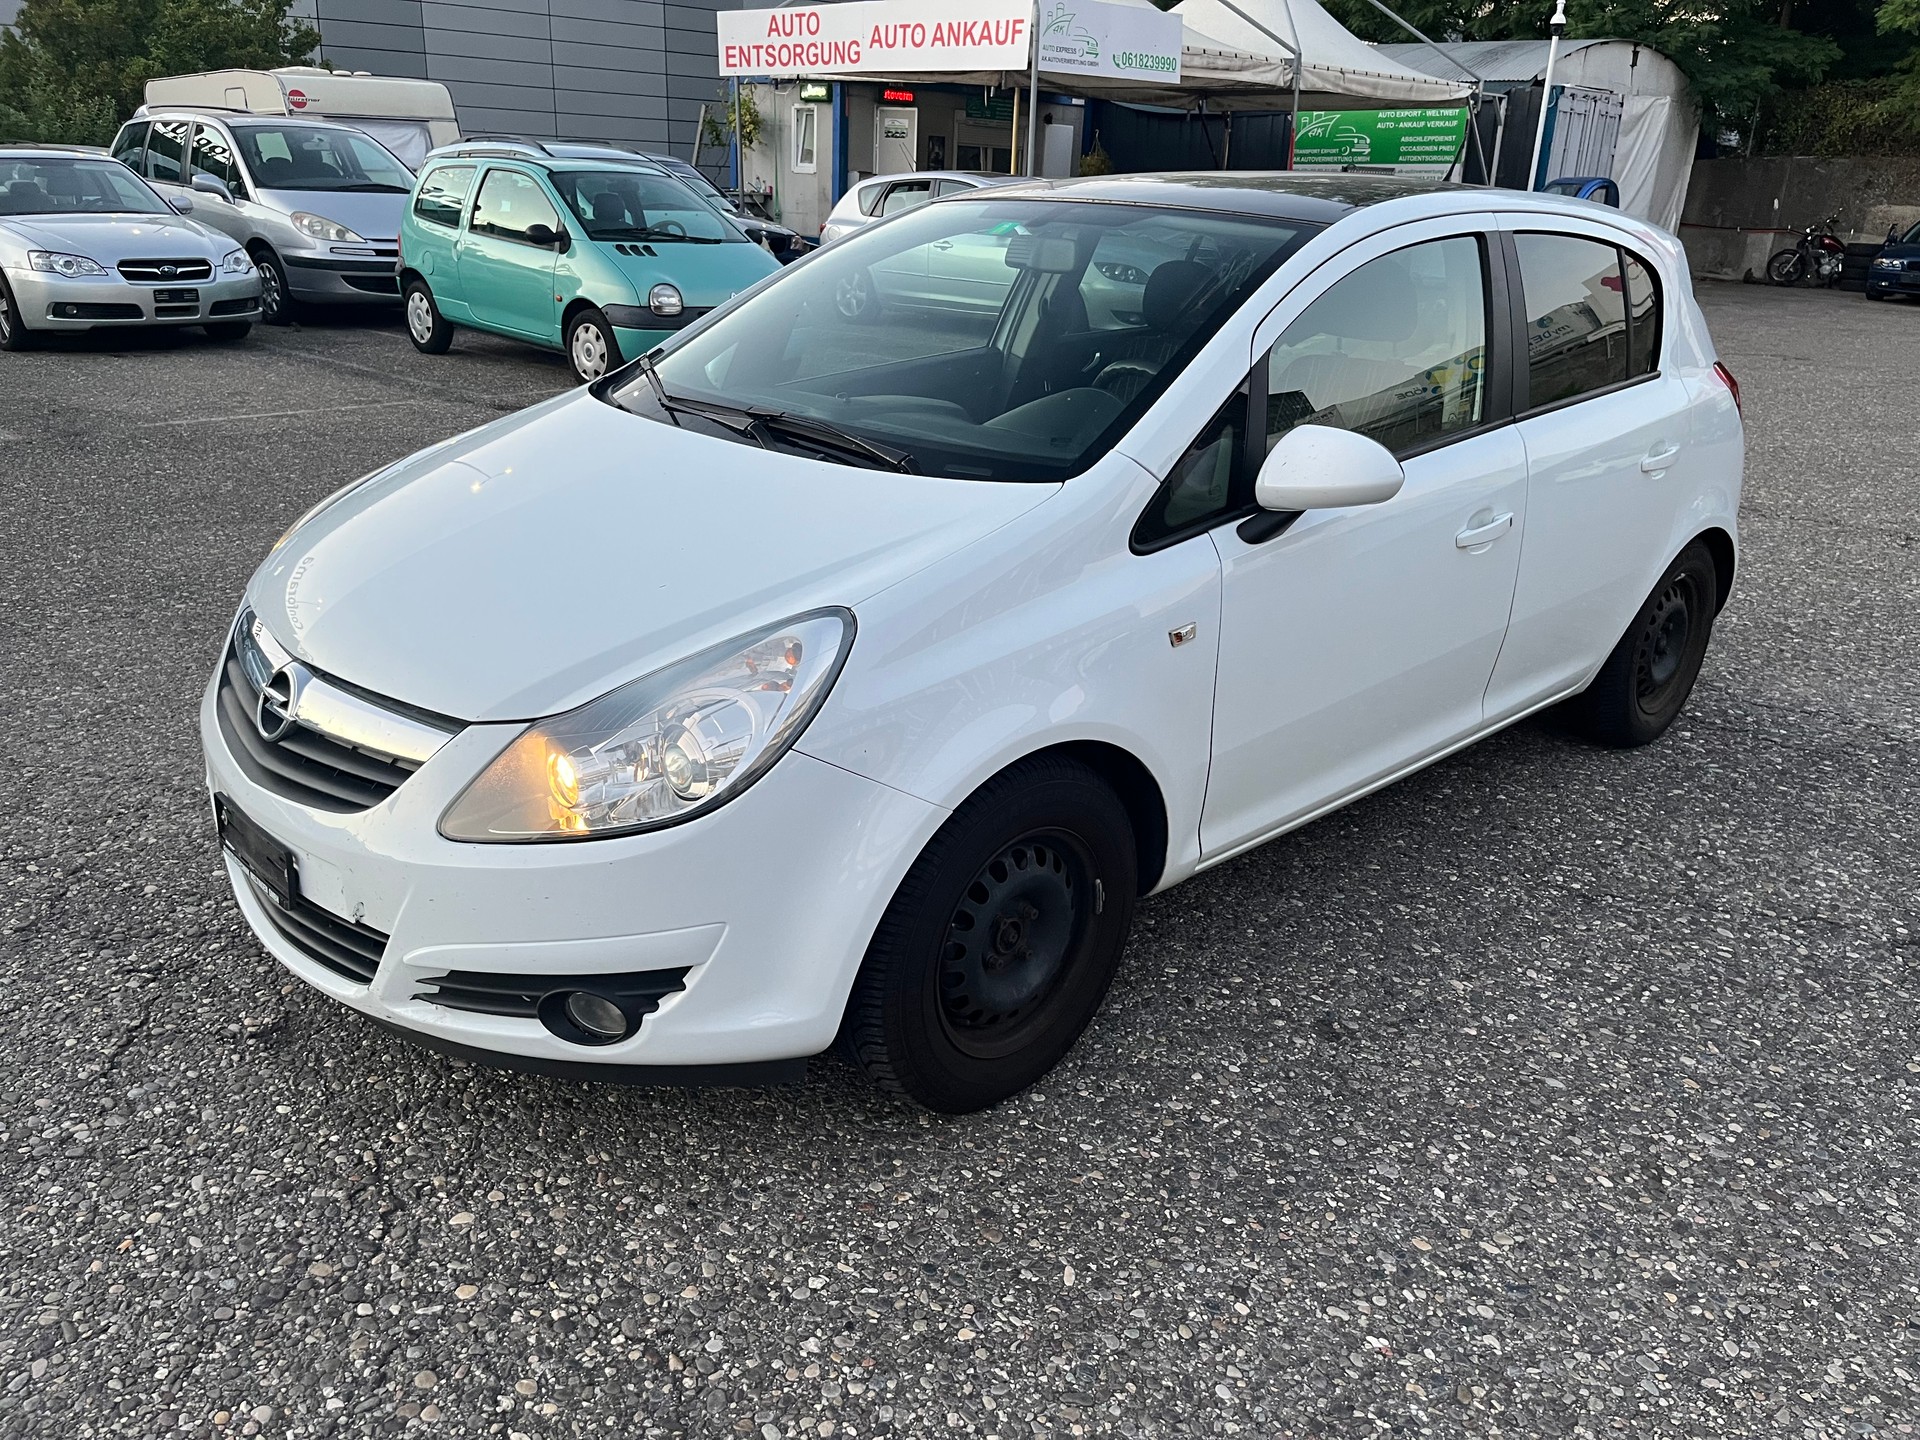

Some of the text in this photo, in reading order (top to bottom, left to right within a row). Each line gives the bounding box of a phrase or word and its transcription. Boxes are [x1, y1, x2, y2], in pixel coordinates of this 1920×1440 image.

[767, 11, 820, 37] AUTO
[869, 18, 1025, 49] AUTO ANKAUF
[725, 40, 861, 69] ENTSORGUNG
[1042, 44, 1077, 55] AUTO EXPRESS
[1121, 51, 1177, 71] 0618239990
[1377, 111, 1396, 119] AUTO
[1396, 110, 1422, 118] EXPORT
[1426, 109, 1460, 117] WELTWEIT
[1376, 121, 1395, 129] AUTO
[1426, 120, 1459, 128] VERKAUF
[1307, 127, 1325, 138] AK
